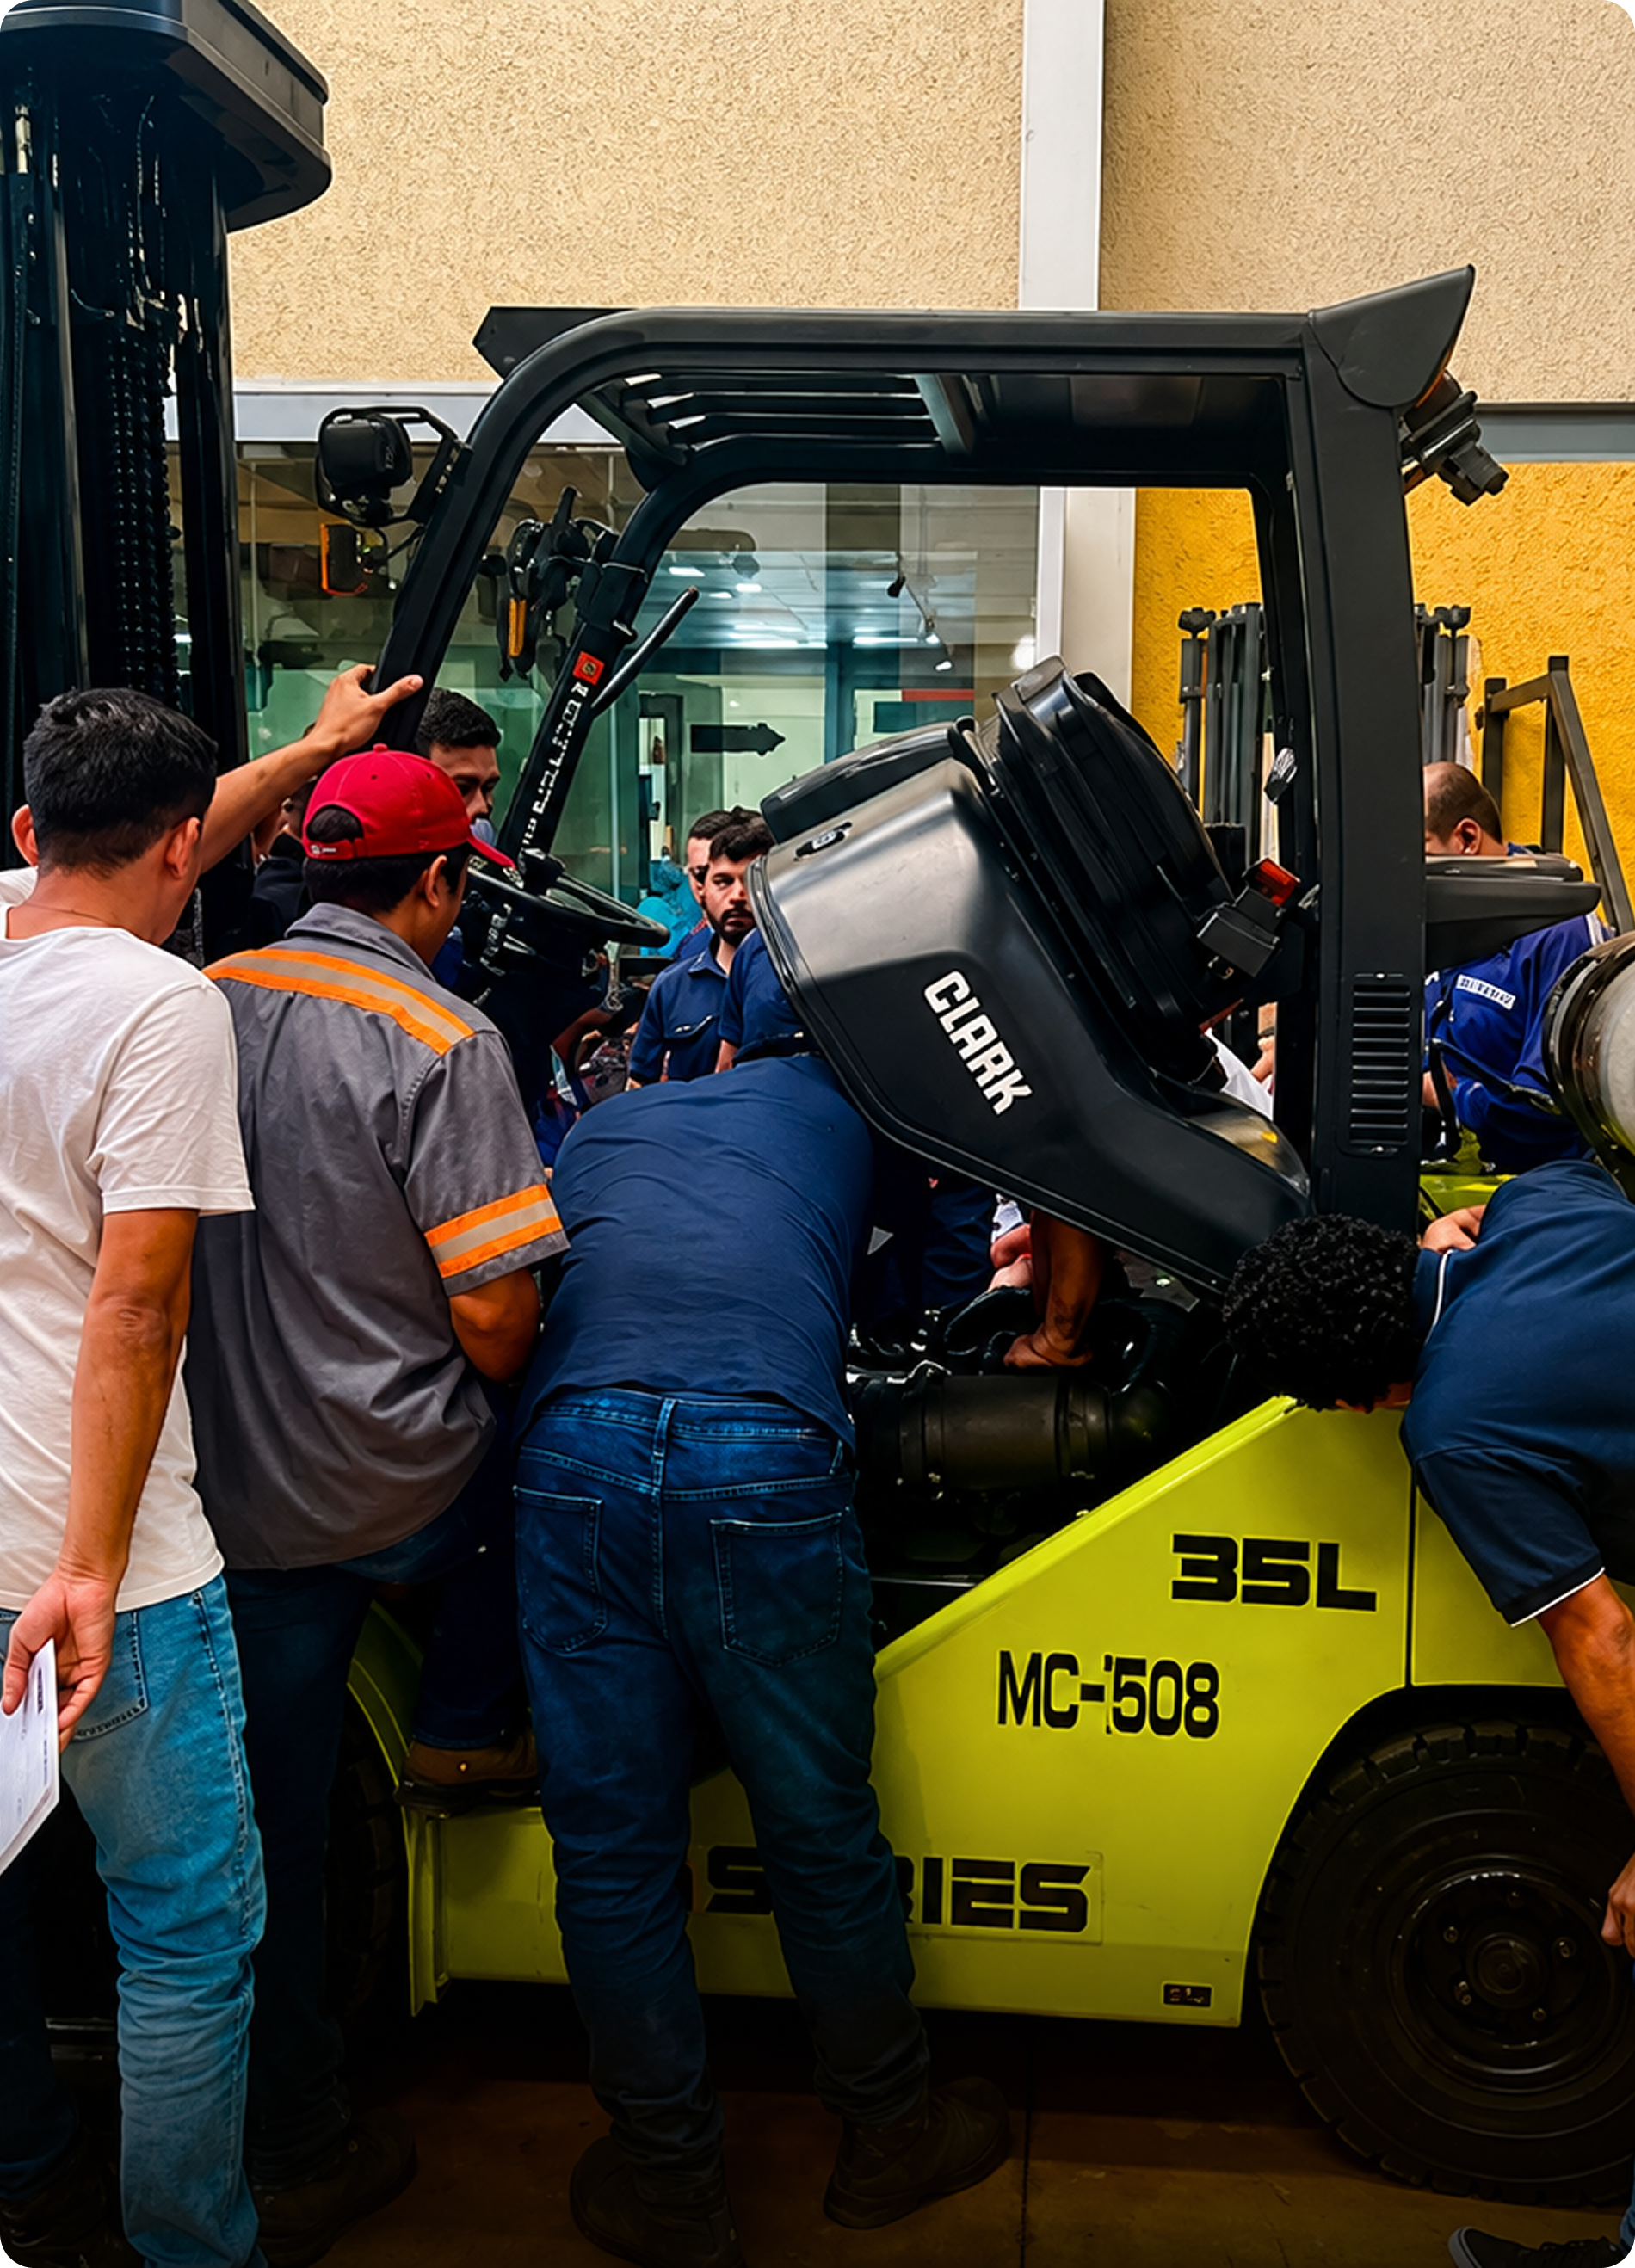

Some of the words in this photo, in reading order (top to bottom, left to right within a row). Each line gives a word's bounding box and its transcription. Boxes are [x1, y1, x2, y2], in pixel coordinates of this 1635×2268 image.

[923, 970, 1033, 1116] CLARK
[1171, 1533, 1377, 1612] 35L
[704, 1845, 1090, 1933] SIES
